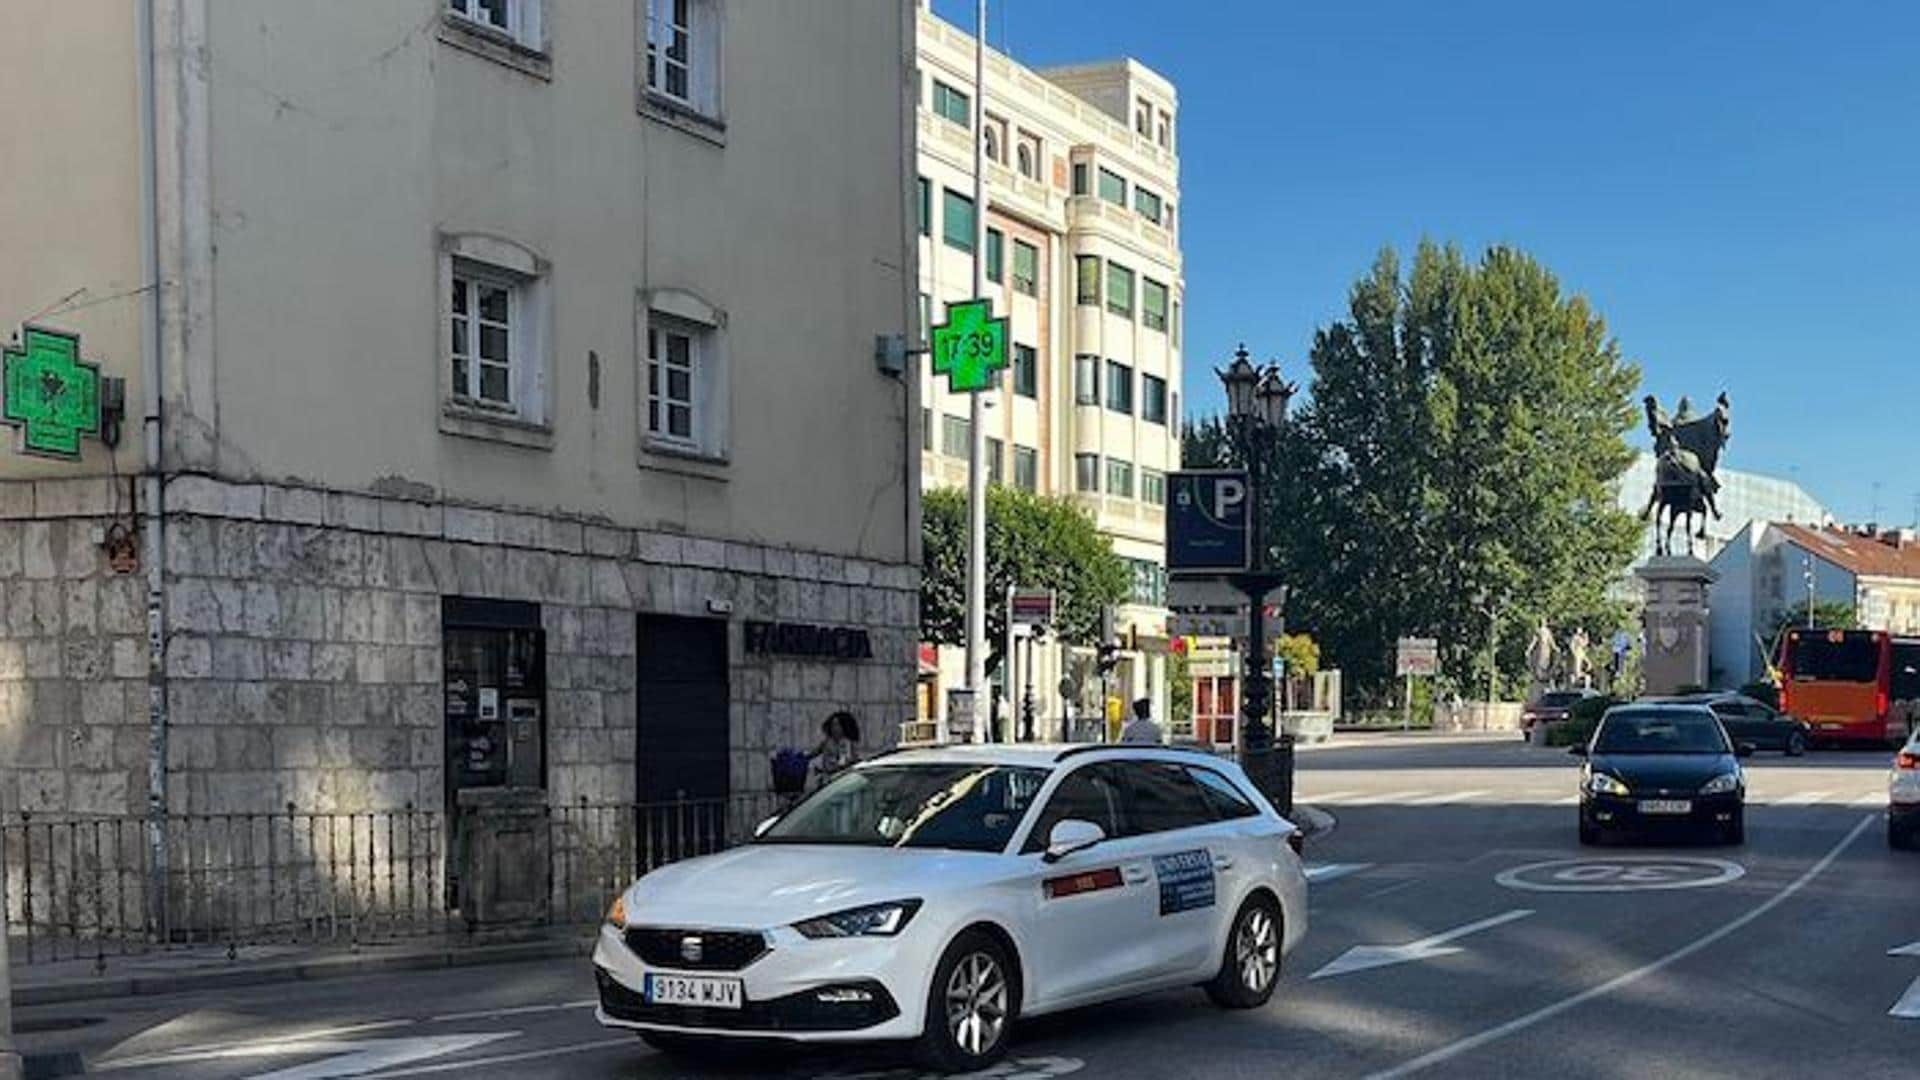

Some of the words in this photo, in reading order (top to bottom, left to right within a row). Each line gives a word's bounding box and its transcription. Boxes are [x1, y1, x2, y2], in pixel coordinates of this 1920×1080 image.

[1214, 479, 1246, 519] P
[745, 622, 872, 658] FARMACIA
[655, 979, 696, 1001] 9134
[702, 982, 736, 1003] MJV
